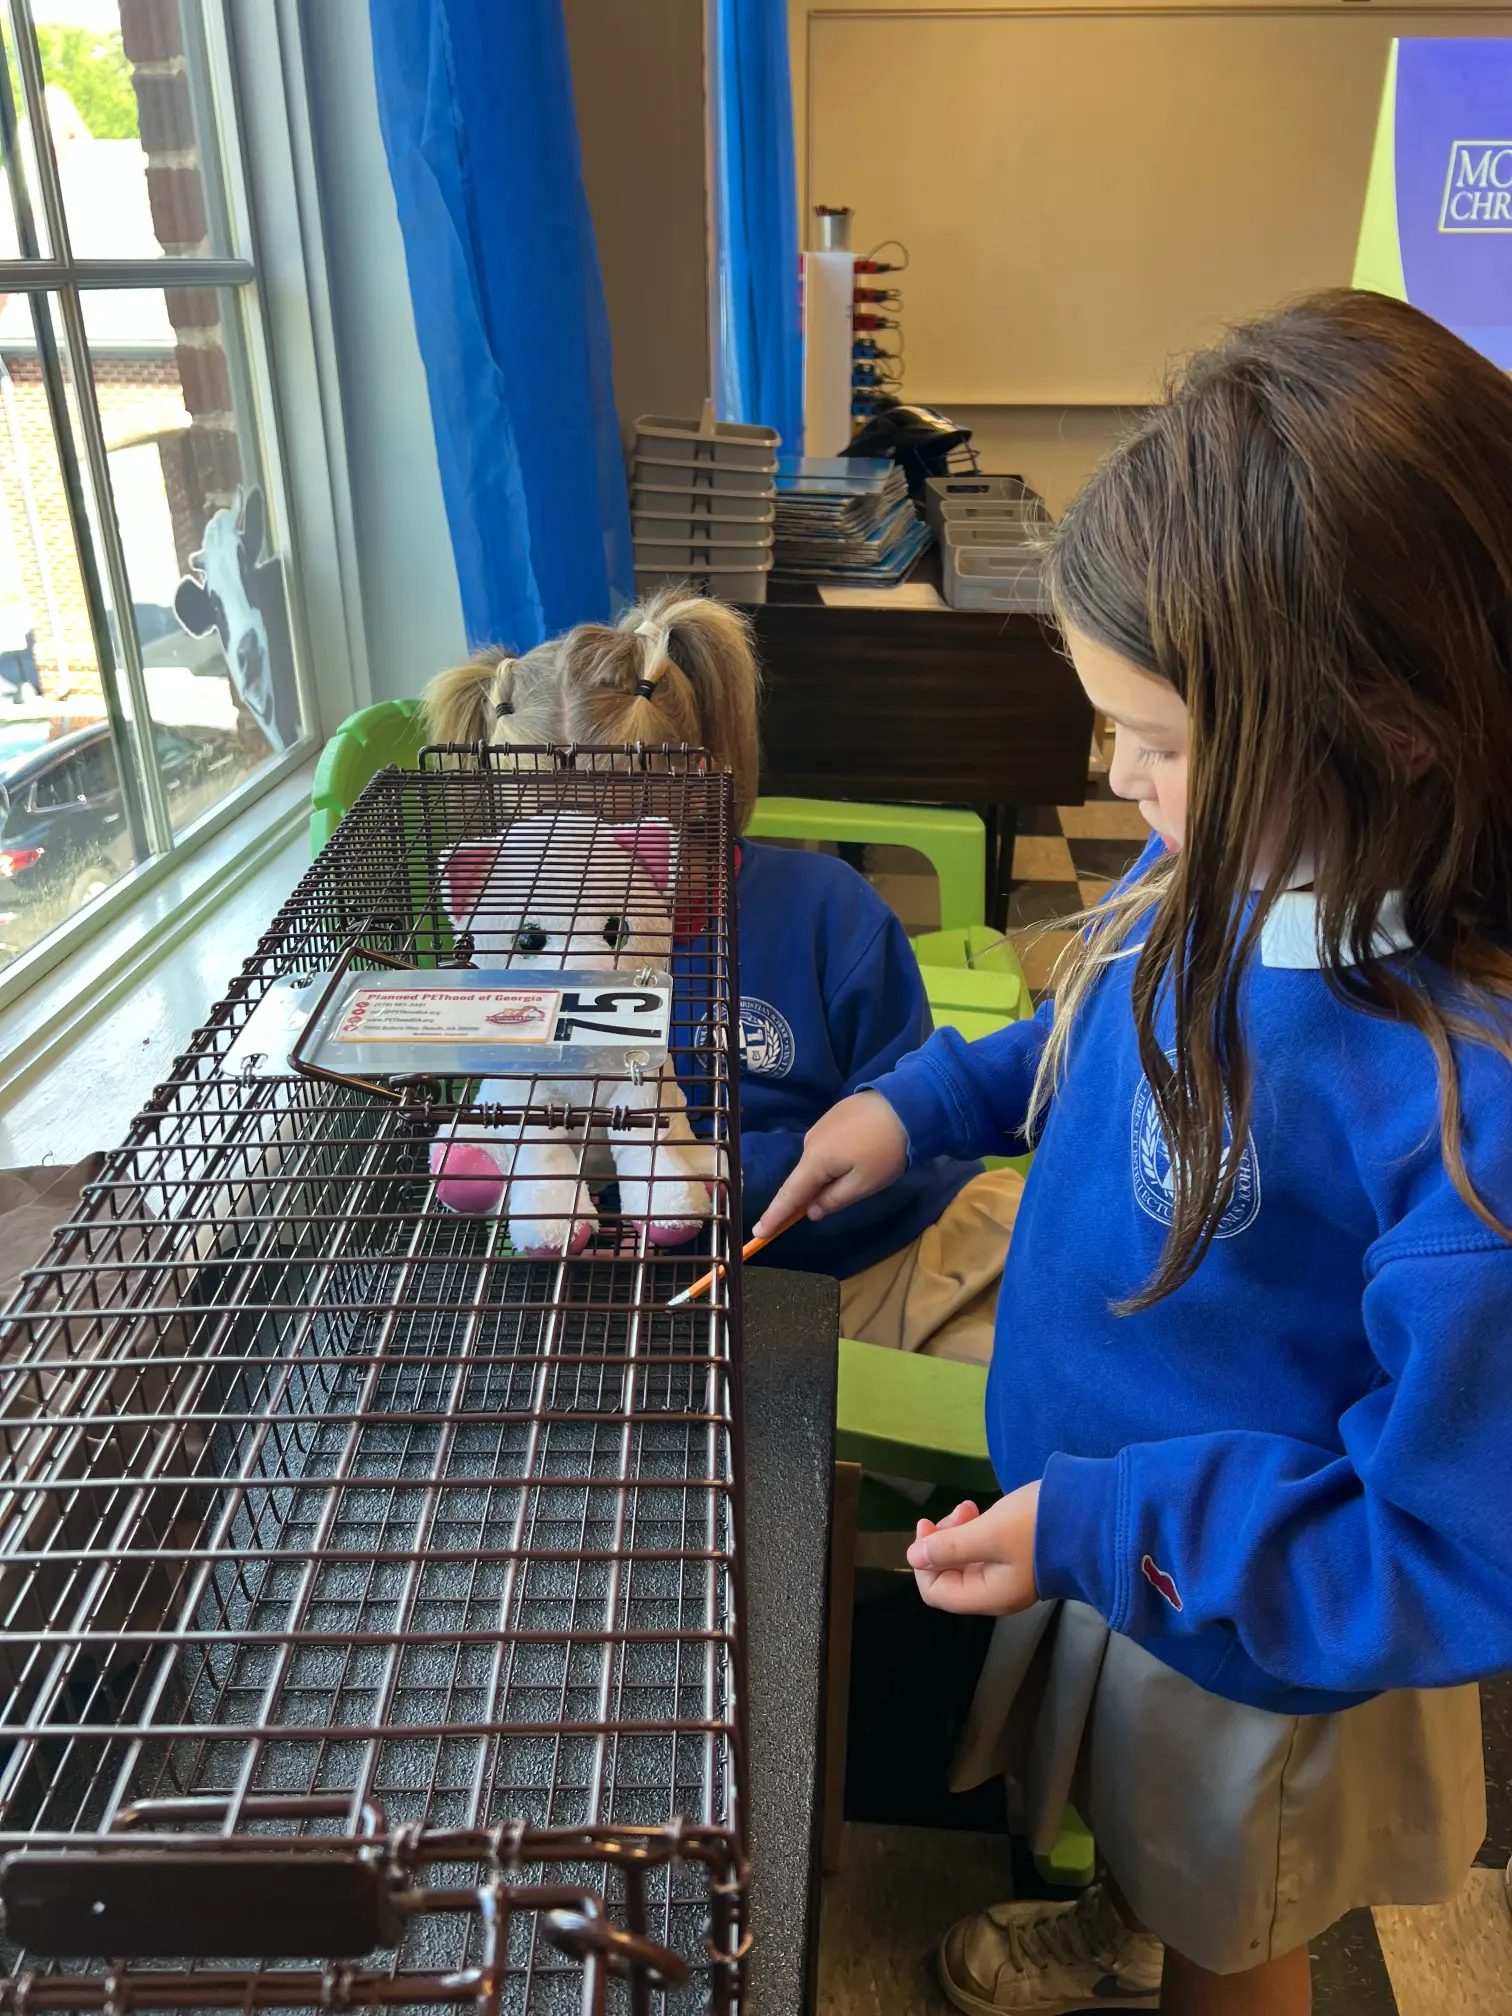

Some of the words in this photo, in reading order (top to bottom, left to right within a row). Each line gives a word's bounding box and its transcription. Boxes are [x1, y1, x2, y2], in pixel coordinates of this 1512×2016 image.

[367, 993, 419, 1001] Planned
[421, 993, 475, 1001] PEThood
[495, 994, 543, 1003] Georgia
[1132, 1149, 1175, 1219] INTELLECTU
